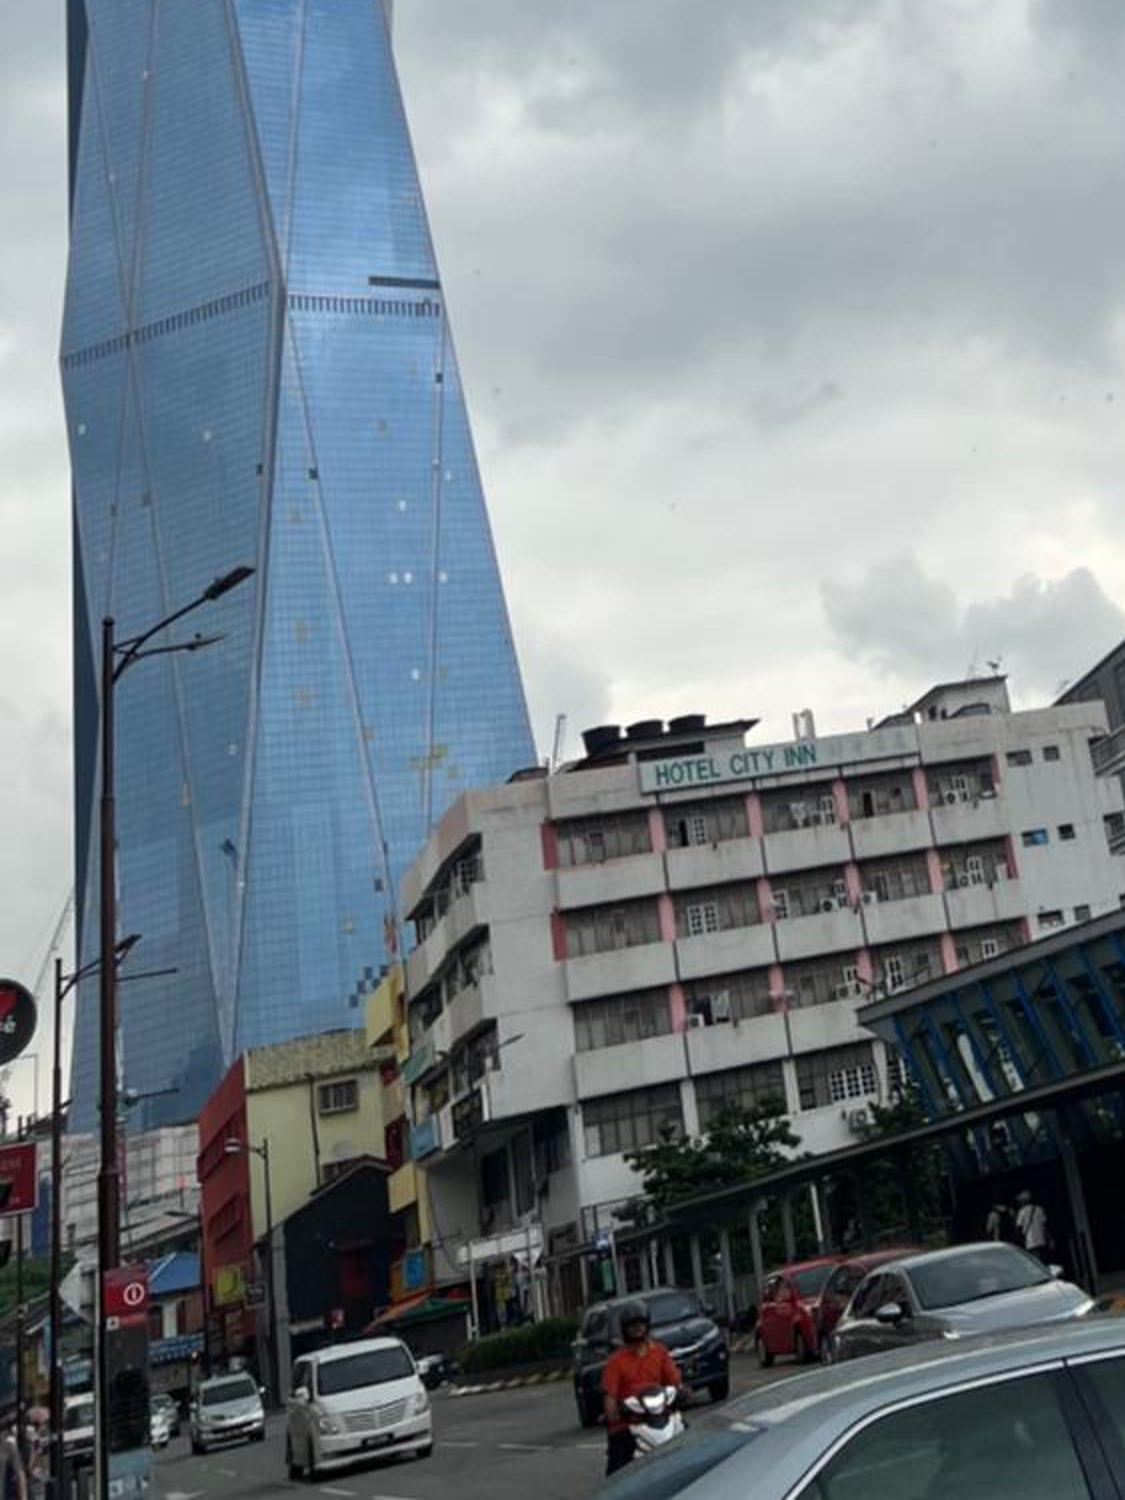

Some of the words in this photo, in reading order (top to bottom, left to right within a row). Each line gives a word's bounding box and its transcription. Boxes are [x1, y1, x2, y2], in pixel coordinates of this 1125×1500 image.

[655, 759, 721, 786] HOTEL
[729, 750, 775, 775] CITY
[783, 745, 817, 766] INN
